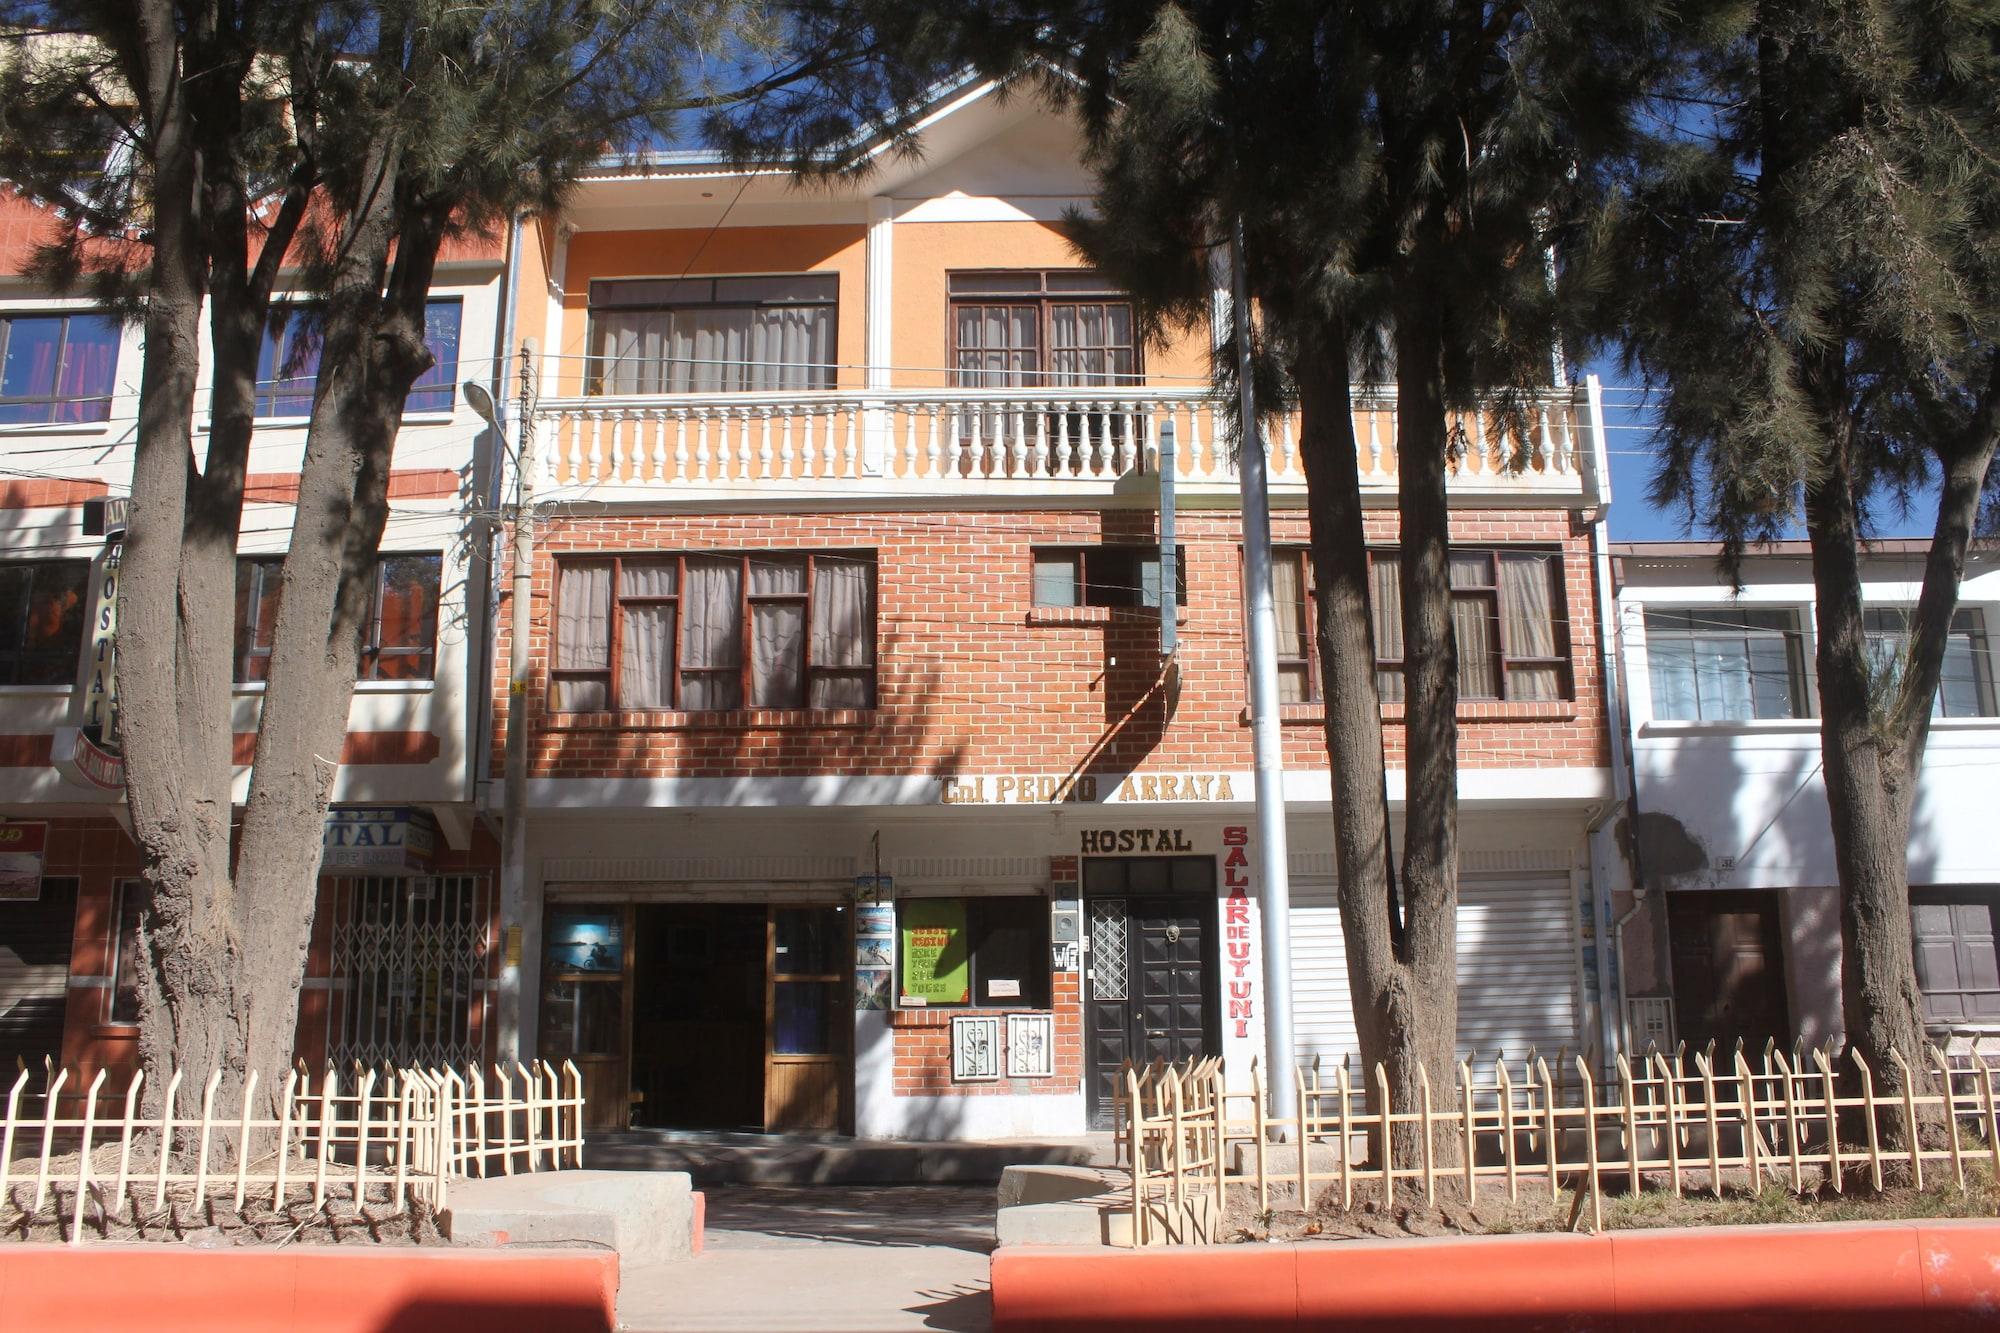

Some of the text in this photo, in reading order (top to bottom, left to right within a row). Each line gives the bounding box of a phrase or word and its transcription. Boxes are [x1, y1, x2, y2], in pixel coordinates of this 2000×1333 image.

[995, 775, 1097, 802] PEDRO
[1118, 775, 1234, 801] ARRAYA
[323, 823, 402, 846] TAL
[1081, 828, 1192, 853] HOSTAL
[1223, 826, 1253, 1039] SALAR DE UYUNI
